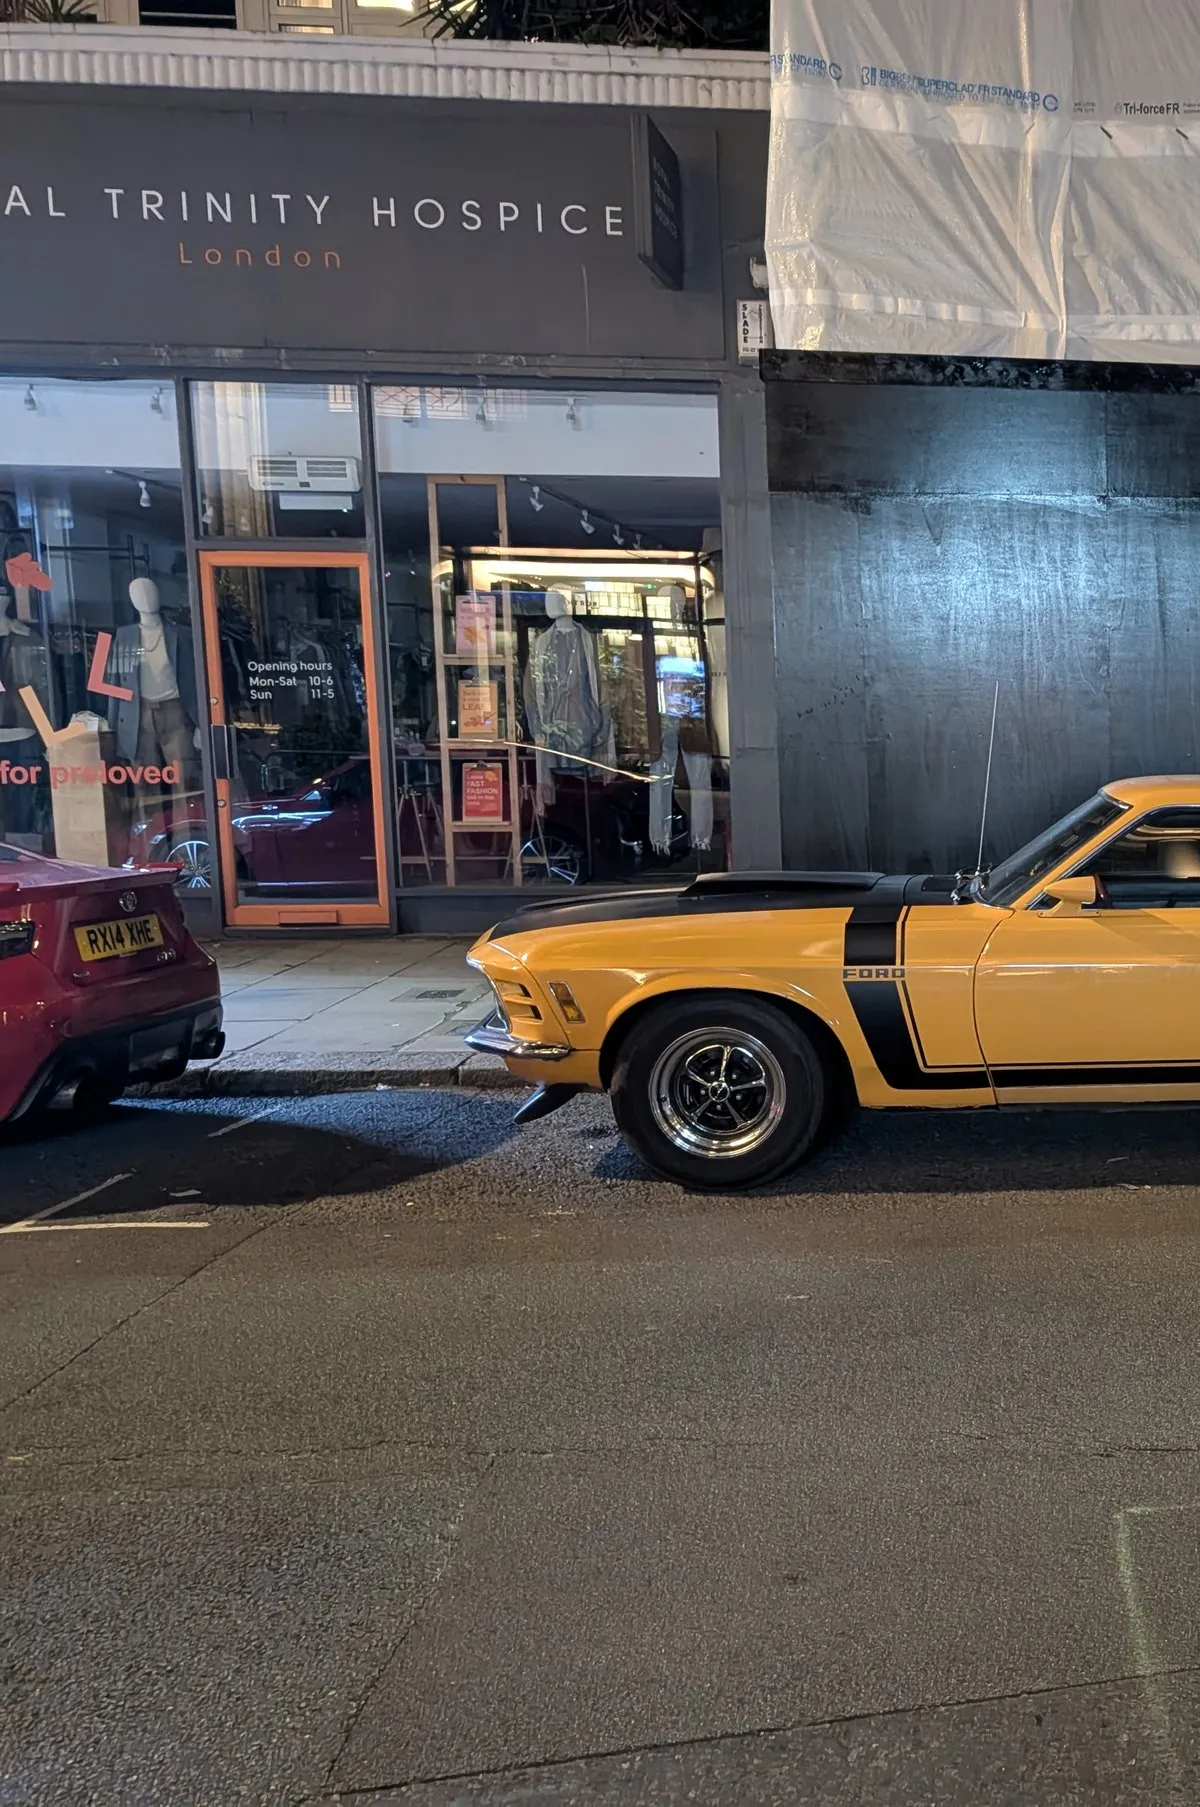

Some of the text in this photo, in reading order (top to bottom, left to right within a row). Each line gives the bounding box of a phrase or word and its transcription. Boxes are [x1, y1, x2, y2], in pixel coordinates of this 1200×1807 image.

[991, 86, 1040, 103] STANDARD
[1123, 102, 1165, 115] Tri-force
[1166, 103, 1180, 114] FR
[4, 184, 66, 217] AL
[104, 187, 330, 225] TRINITY
[372, 196, 623, 236] HOSPICE
[178, 242, 343, 269] London
[741, 303, 750, 344] SLADE
[247, 661, 333, 673] Opening hours
[249, 676, 334, 687] Mon-Sat 10-6
[250, 688, 335, 700] Sun 11-5
[0, 760, 181, 789] for preloved
[466, 787, 498, 795] FASHION
[86, 924, 125, 955] RX14
[125, 919, 155, 947] XHE
[842, 968, 905, 979] FORD
